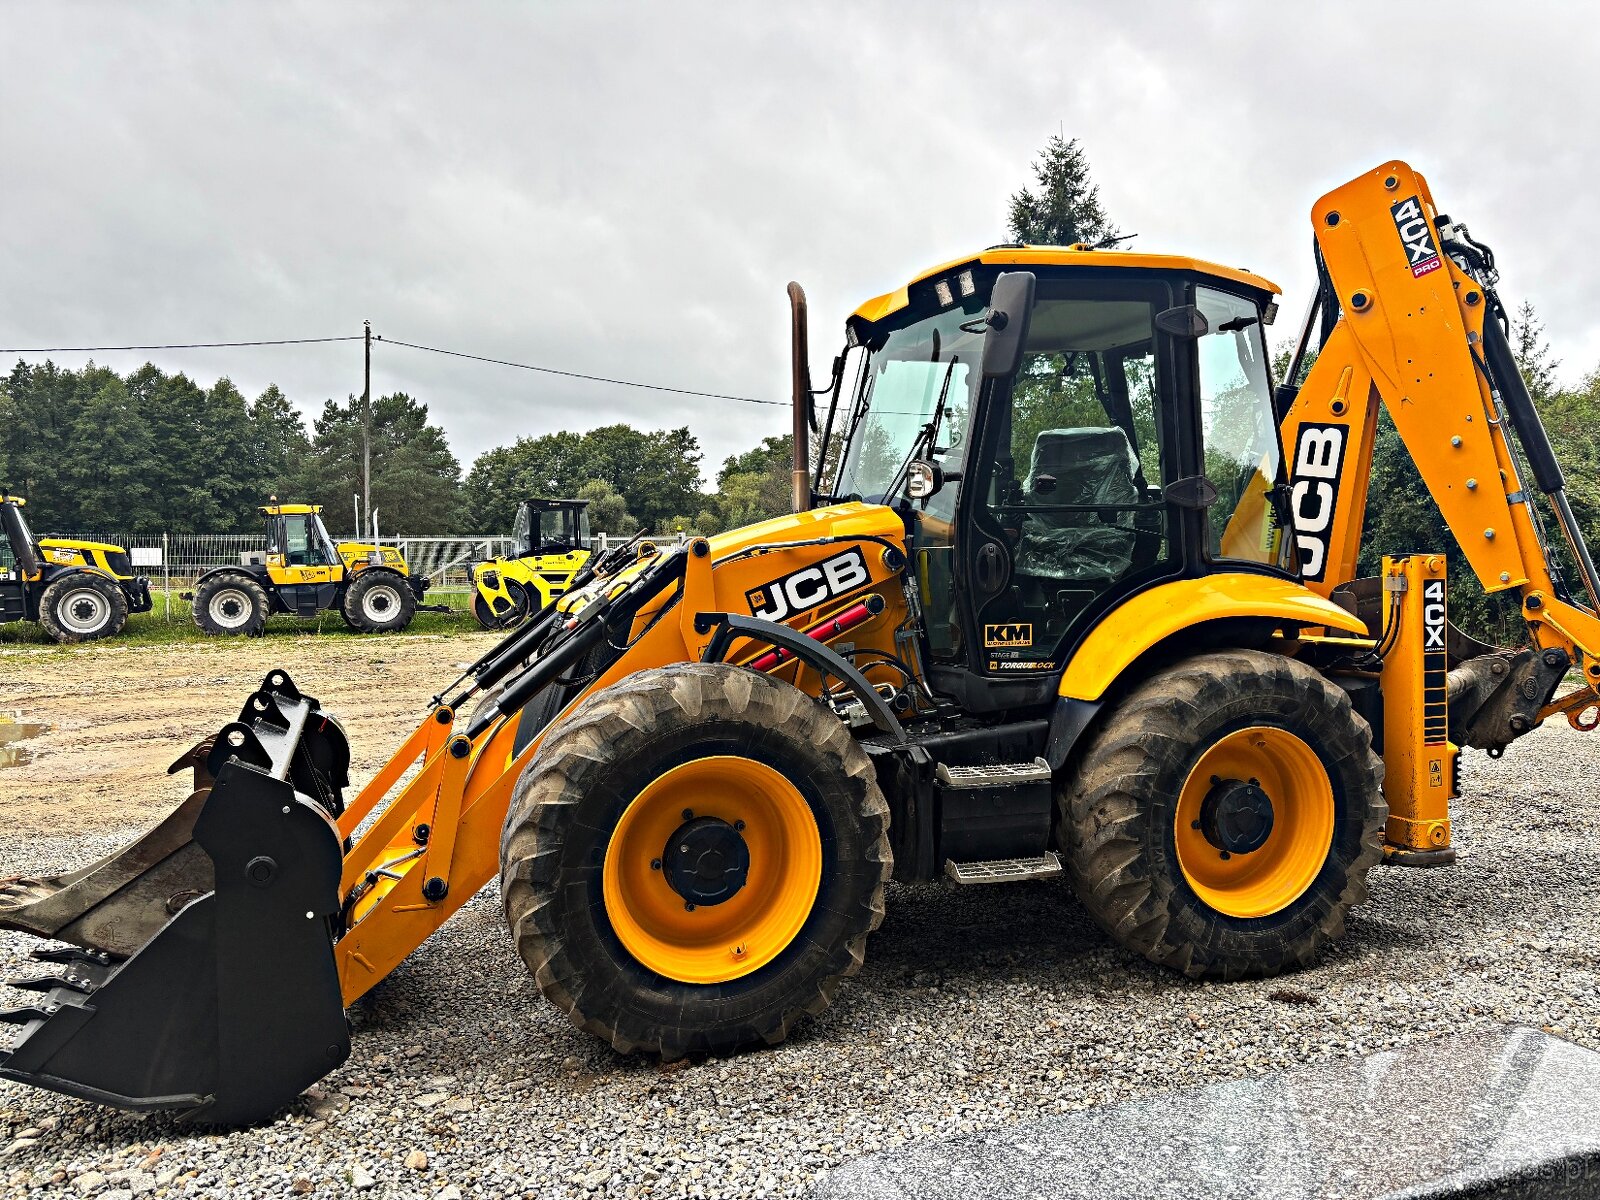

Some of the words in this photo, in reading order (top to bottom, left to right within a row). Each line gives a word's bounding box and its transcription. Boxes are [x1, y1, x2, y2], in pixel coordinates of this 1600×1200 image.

[1395, 199, 1436, 263] 4CX
[1414, 260, 1440, 276] PRO
[1291, 427, 1343, 577] JCB
[755, 551, 867, 623] JCB
[1424, 581, 1445, 647] 4CX
[986, 625, 1031, 640] KM
